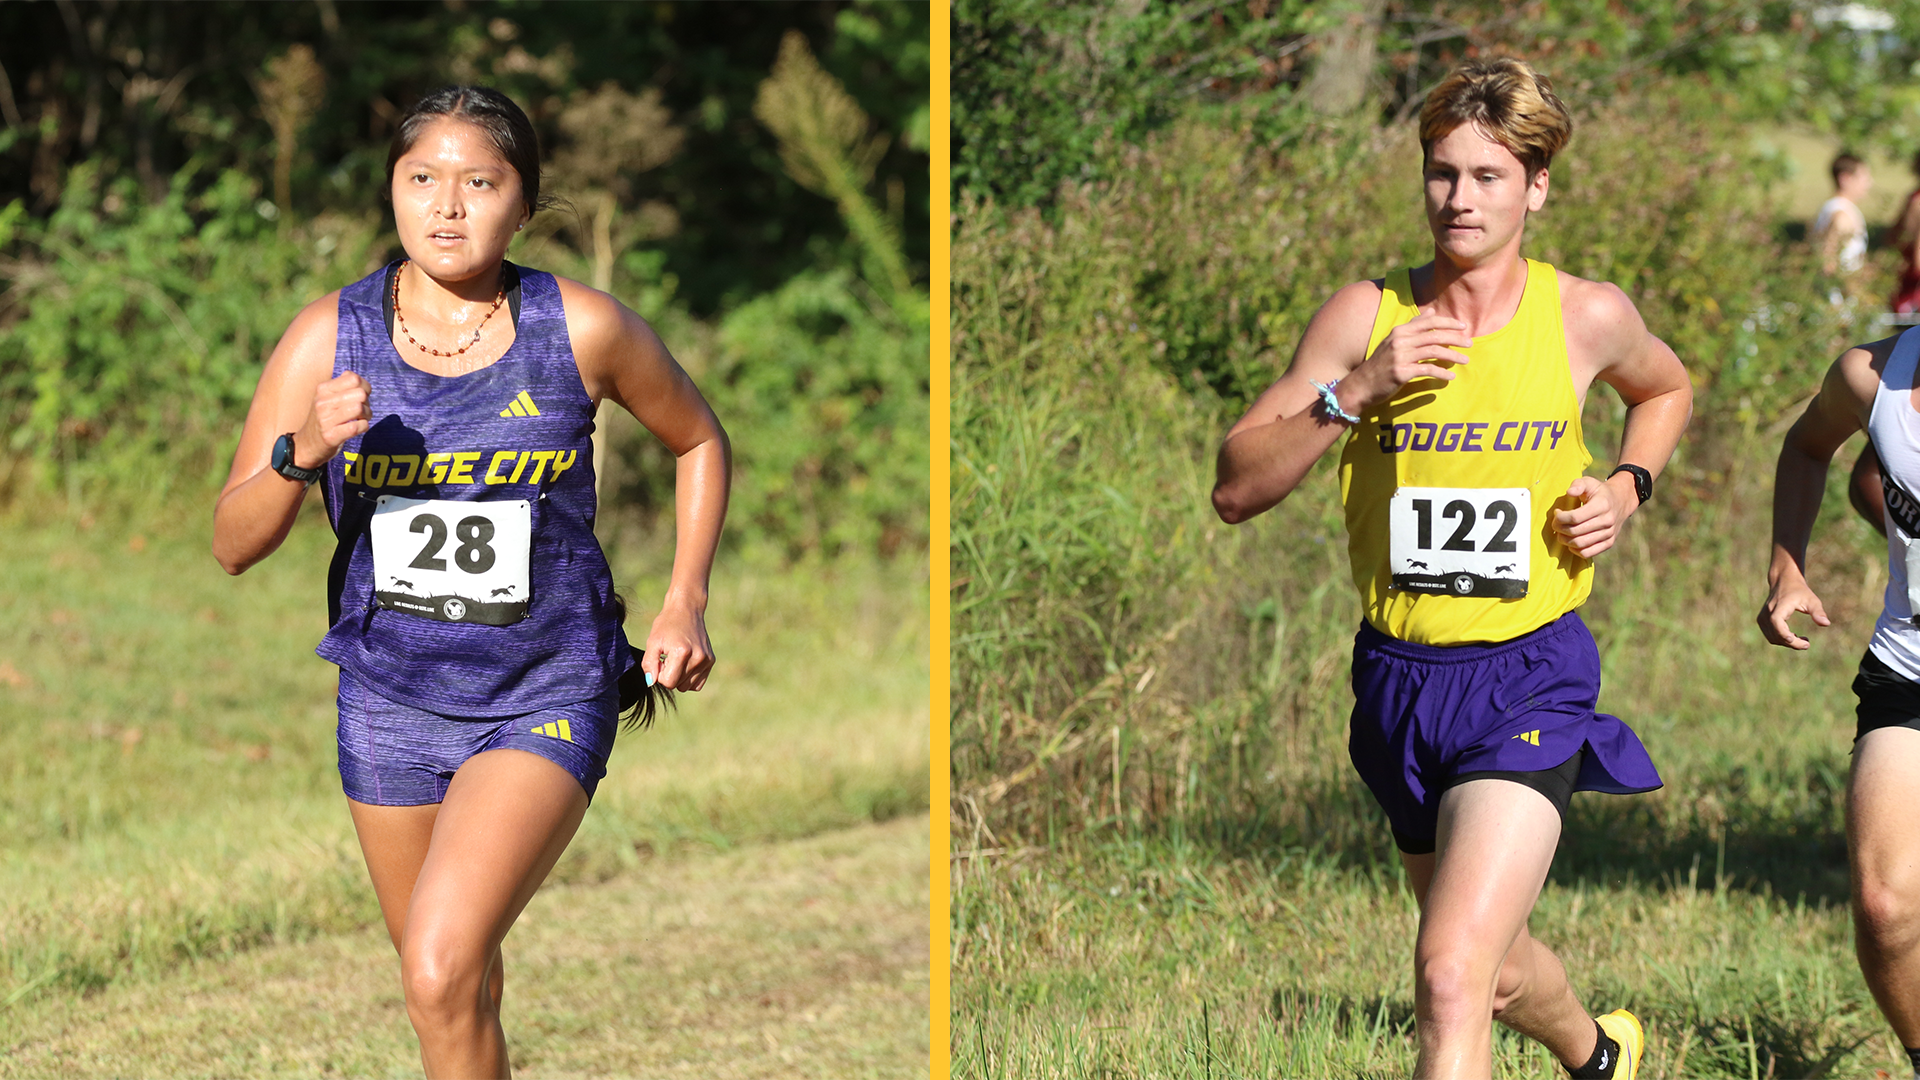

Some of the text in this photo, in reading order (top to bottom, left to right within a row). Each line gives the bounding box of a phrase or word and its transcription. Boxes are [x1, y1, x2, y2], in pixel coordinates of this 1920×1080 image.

[1379, 420, 1568, 454] DODGE CITY
[343, 450, 577, 488] DODGE CITY
[408, 513, 496, 575] 28
[1412, 499, 1518, 552] 122
